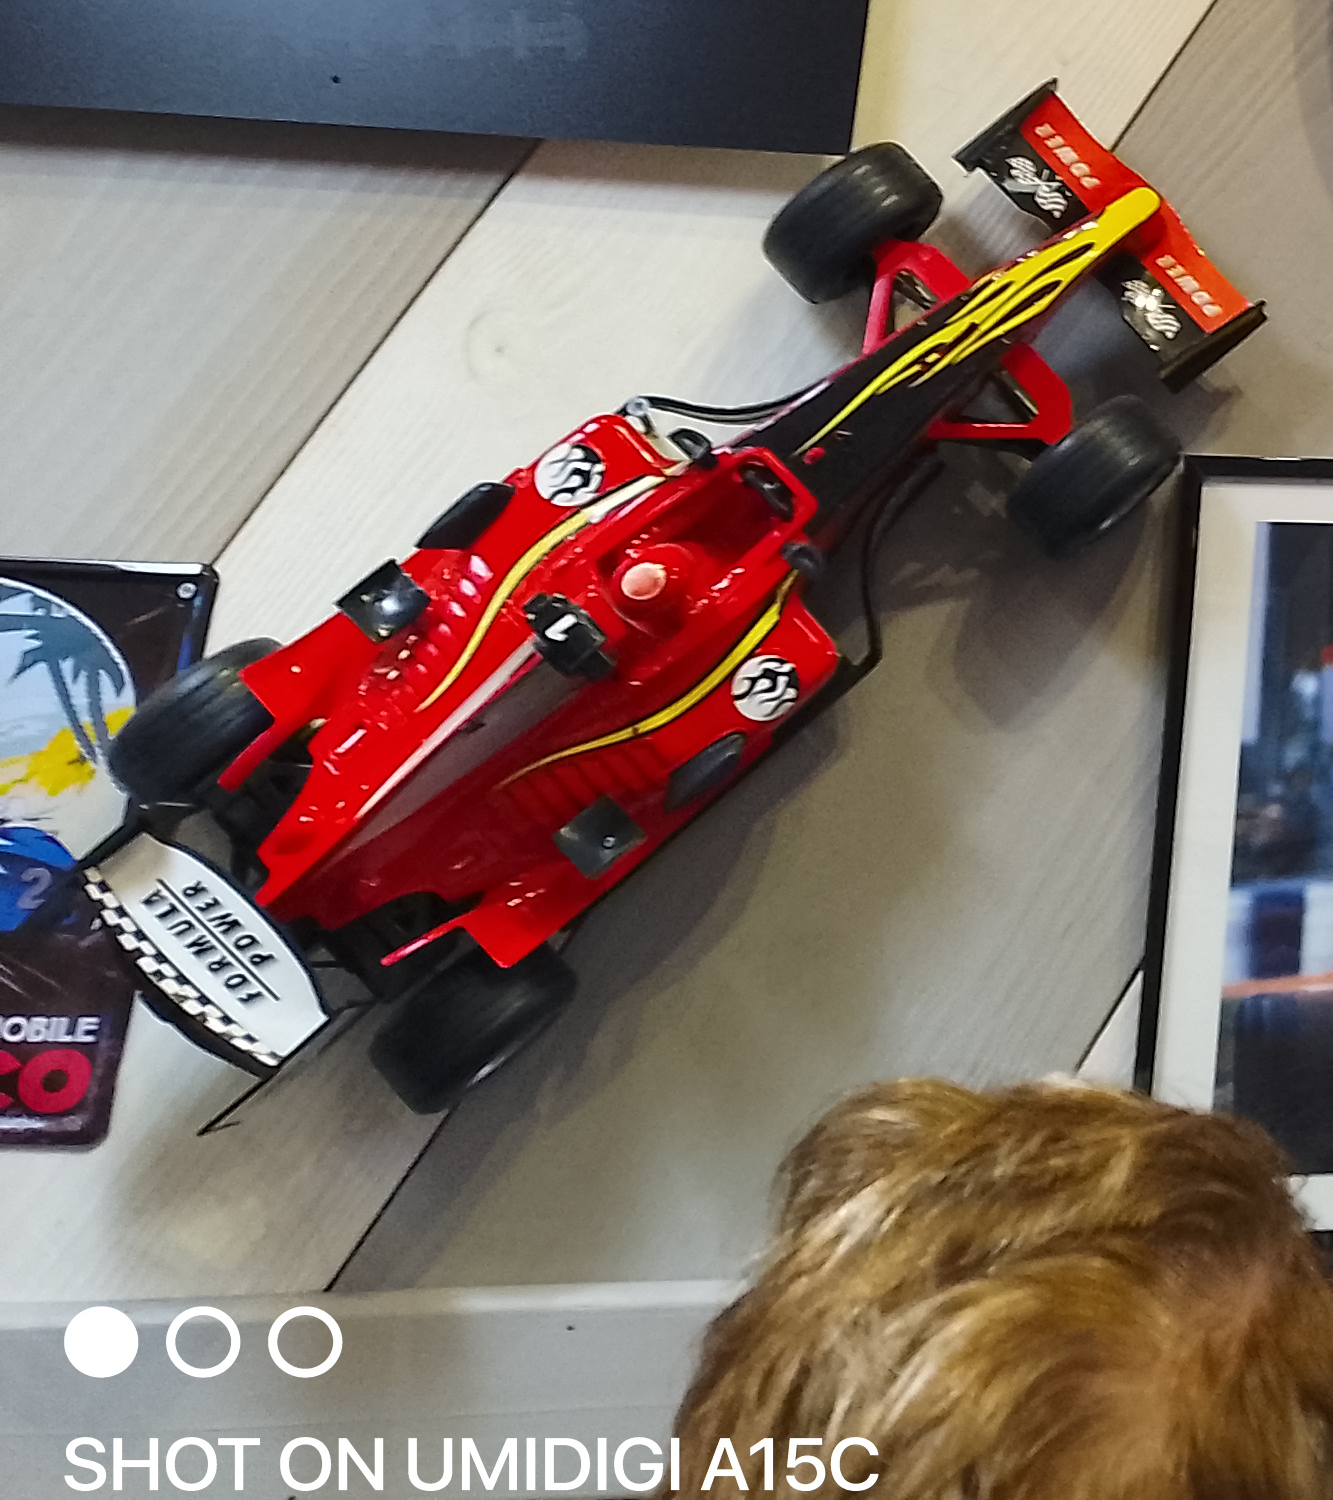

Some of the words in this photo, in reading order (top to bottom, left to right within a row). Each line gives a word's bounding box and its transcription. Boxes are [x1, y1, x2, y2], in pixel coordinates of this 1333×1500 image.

[16, 867, 53, 910] 2
[140, 888, 266, 1005] FORMULA
[182, 880, 277, 967] POWER
[0, 1015, 101, 1042] OBILE
